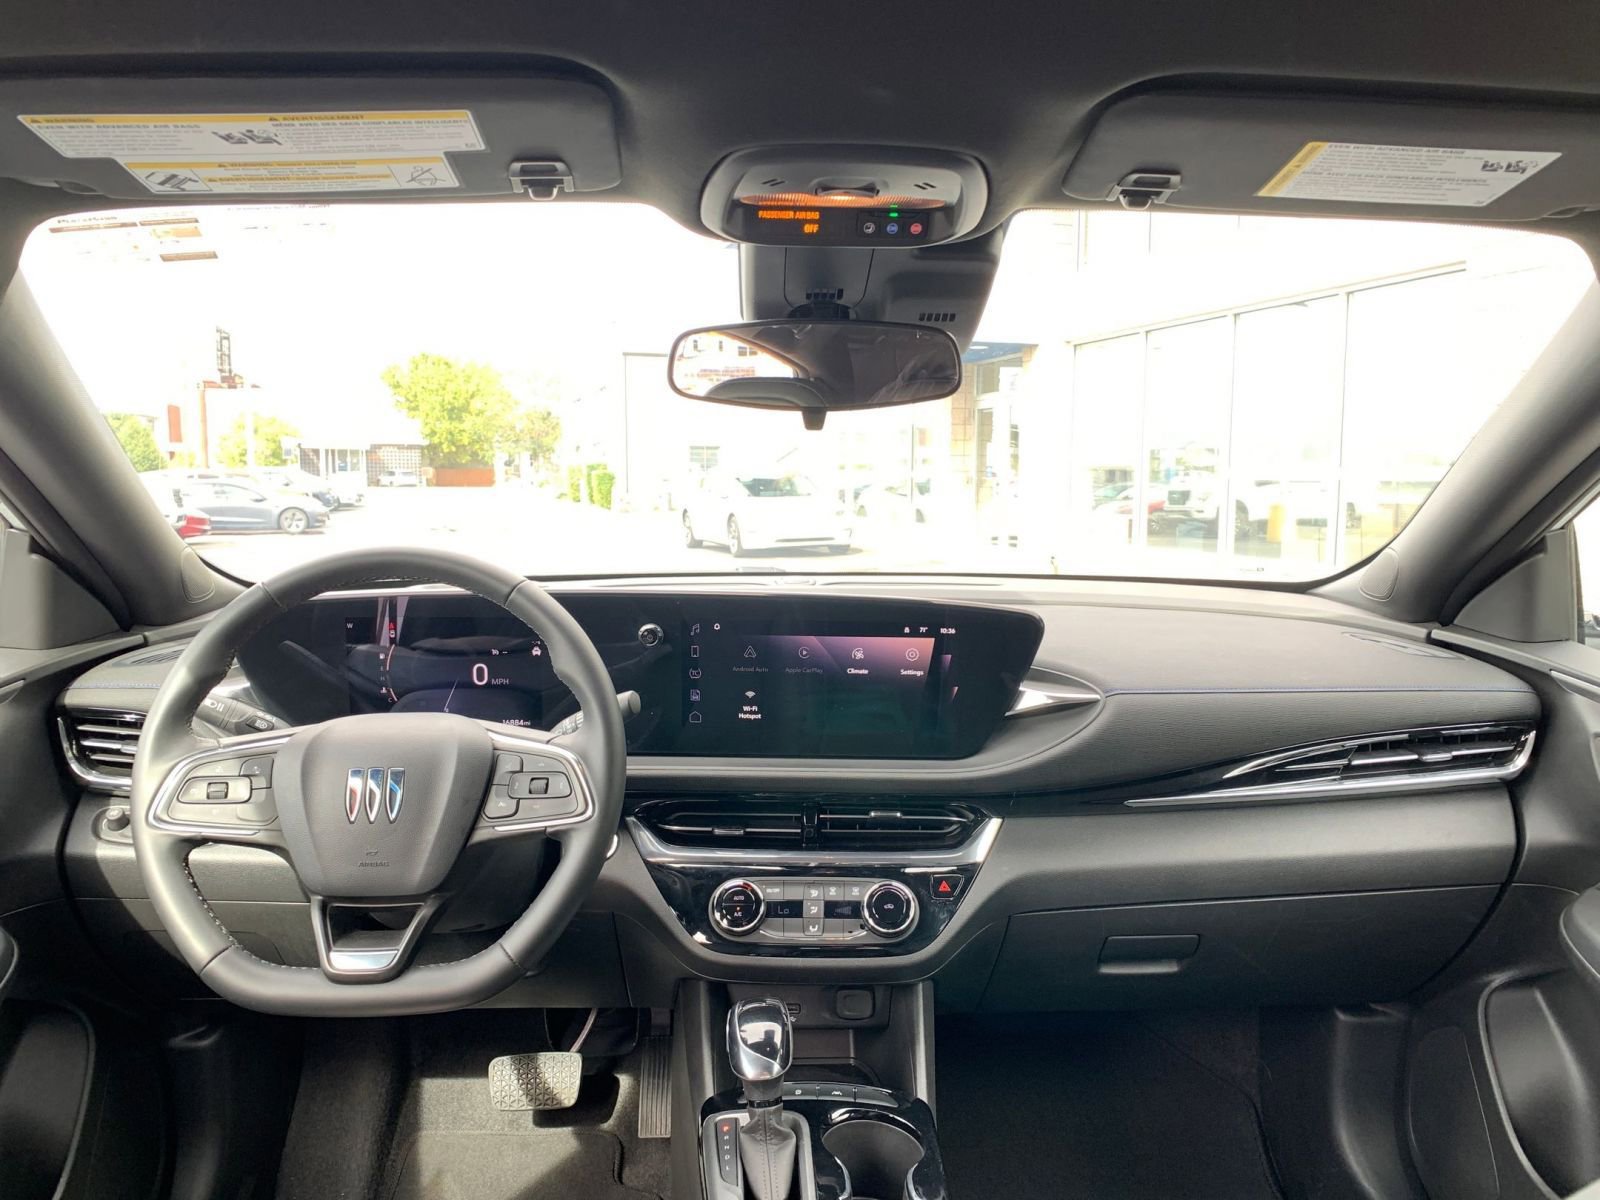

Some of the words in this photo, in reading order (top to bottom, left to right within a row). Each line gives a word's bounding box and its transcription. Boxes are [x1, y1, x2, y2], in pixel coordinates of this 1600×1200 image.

[758, 210, 794, 219] PASSENGER
[803, 223, 819, 233] OFF
[732, 665, 755, 673] Android
[785, 667, 801, 675] Apple
[802, 667, 824, 675] CarPlay
[900, 668, 925, 677] Settings
[471, 662, 489, 686] 0
[742, 704, 758, 712] Wi-Fi
[738, 712, 762, 720] Hotspot
[778, 905, 790, 914] Lo
